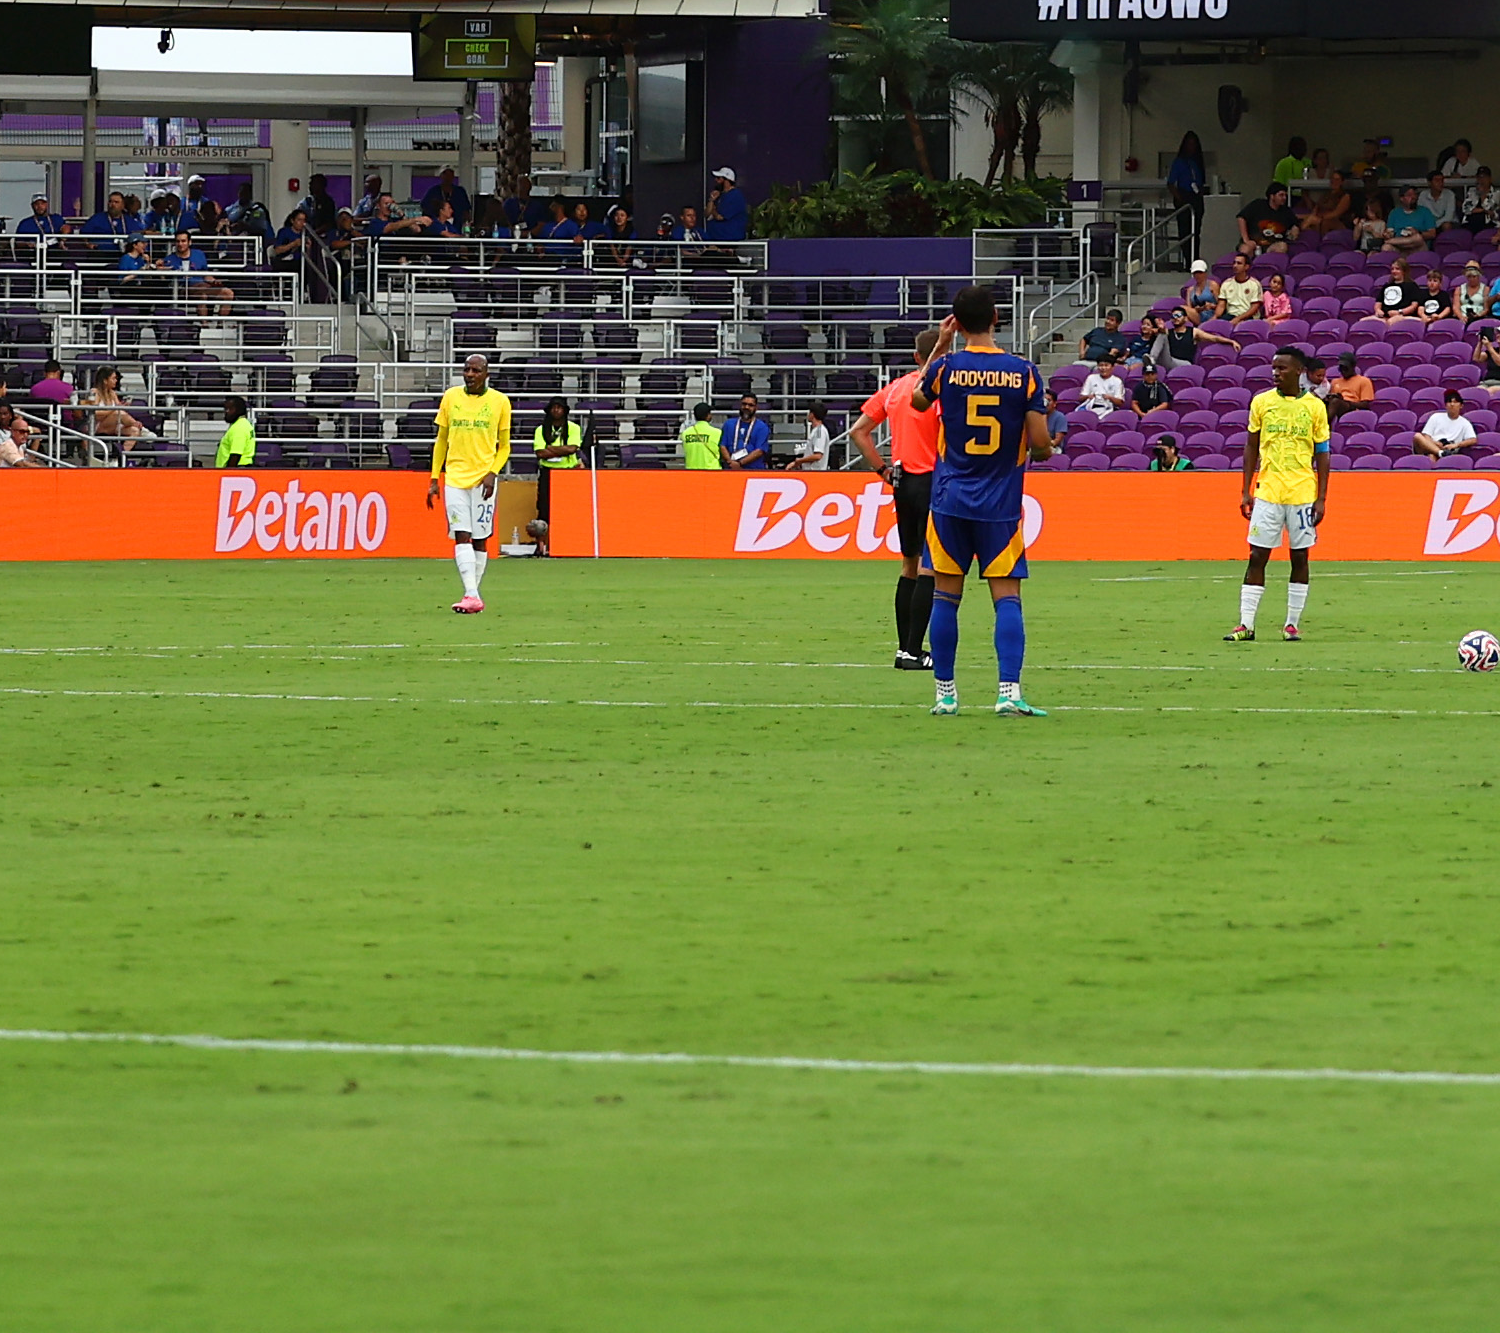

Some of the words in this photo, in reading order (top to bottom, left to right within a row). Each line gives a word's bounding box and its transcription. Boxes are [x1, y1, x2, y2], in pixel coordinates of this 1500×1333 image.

[470, 22, 486, 33] VAR
[465, 43, 490, 53] CHECK
[466, 54, 487, 65] GOAL
[132, 148, 153, 156] EXIT
[156, 148, 168, 156] TO
[170, 148, 209, 157] CHURCH
[212, 148, 248, 157] STREET
[1081, 183, 1088, 199] 1
[948, 370, 1023, 389] WOOYOUNG
[964, 394, 1002, 455] 5
[215, 476, 388, 554] Betano
[477, 504, 493, 523] 25
[1297, 506, 1314, 530] 18
